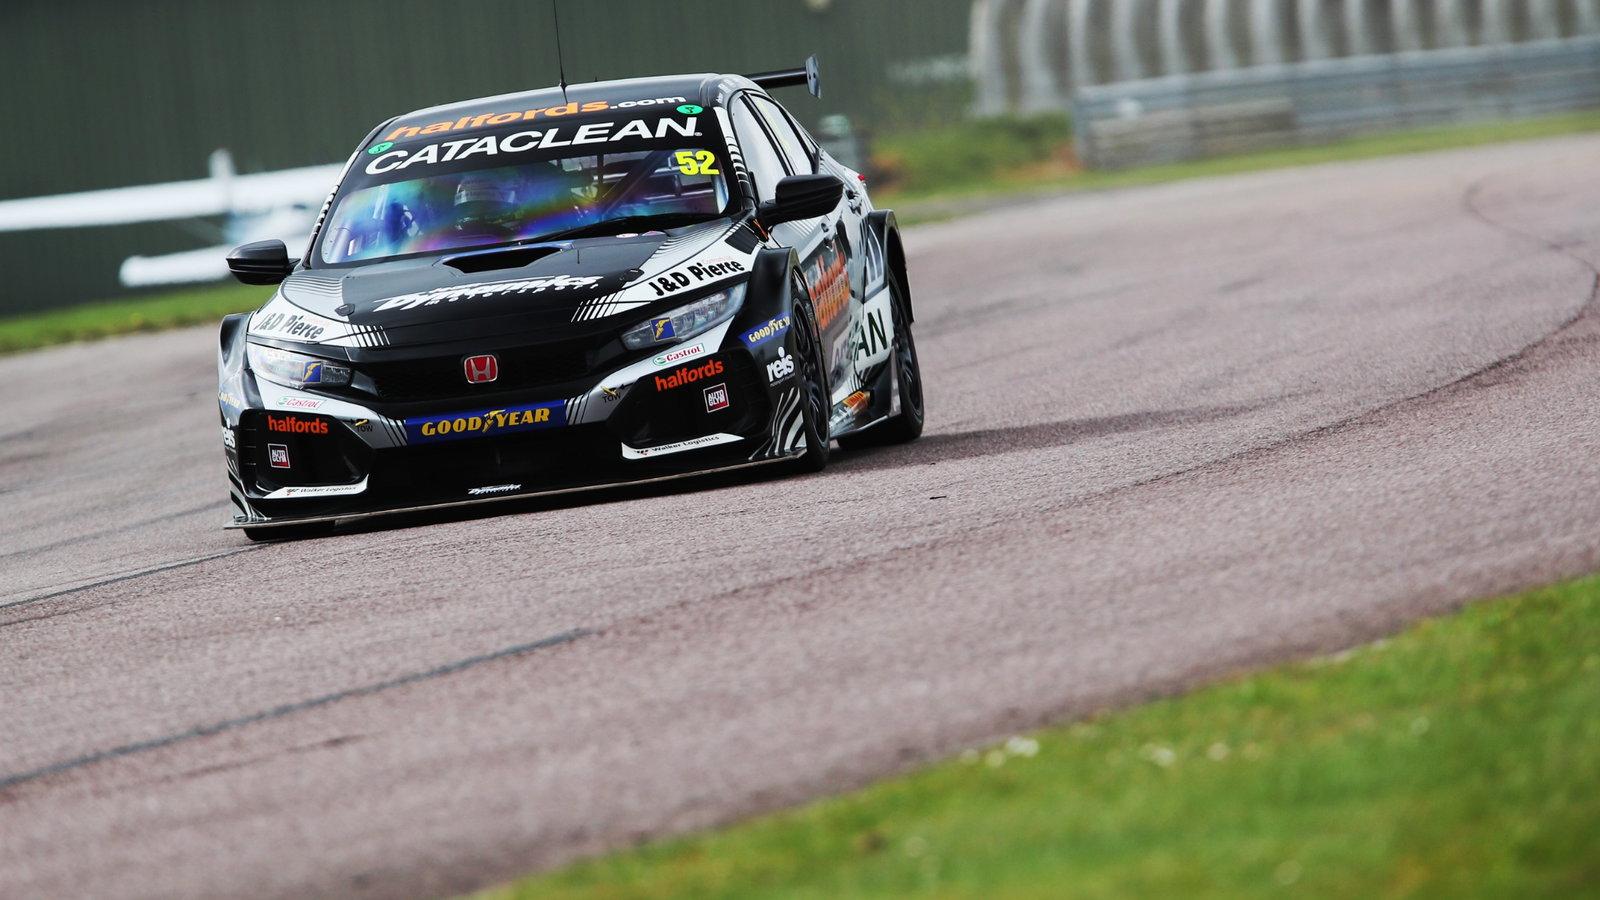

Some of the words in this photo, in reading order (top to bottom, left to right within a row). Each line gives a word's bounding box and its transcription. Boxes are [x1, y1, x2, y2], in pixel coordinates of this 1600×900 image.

[385, 96, 687, 141] halfords.com
[365, 116, 698, 175] CATACLEAN
[675, 150, 720, 175] 52
[648, 271, 691, 296] J&D
[687, 260, 745, 281] Pierce
[253, 312, 282, 332] J&D
[283, 314, 324, 340] Pierce
[666, 345, 701, 362] Castrol
[766, 346, 794, 382] reis
[655, 359, 724, 392] halfords
[286, 398, 320, 409] Castrol
[603, 392, 622, 404] TOW
[708, 389, 724, 401] AUTO
[267, 415, 328, 434] halfords
[421, 407, 550, 436] GOODYEAR
[683, 434, 720, 447] Logistics
